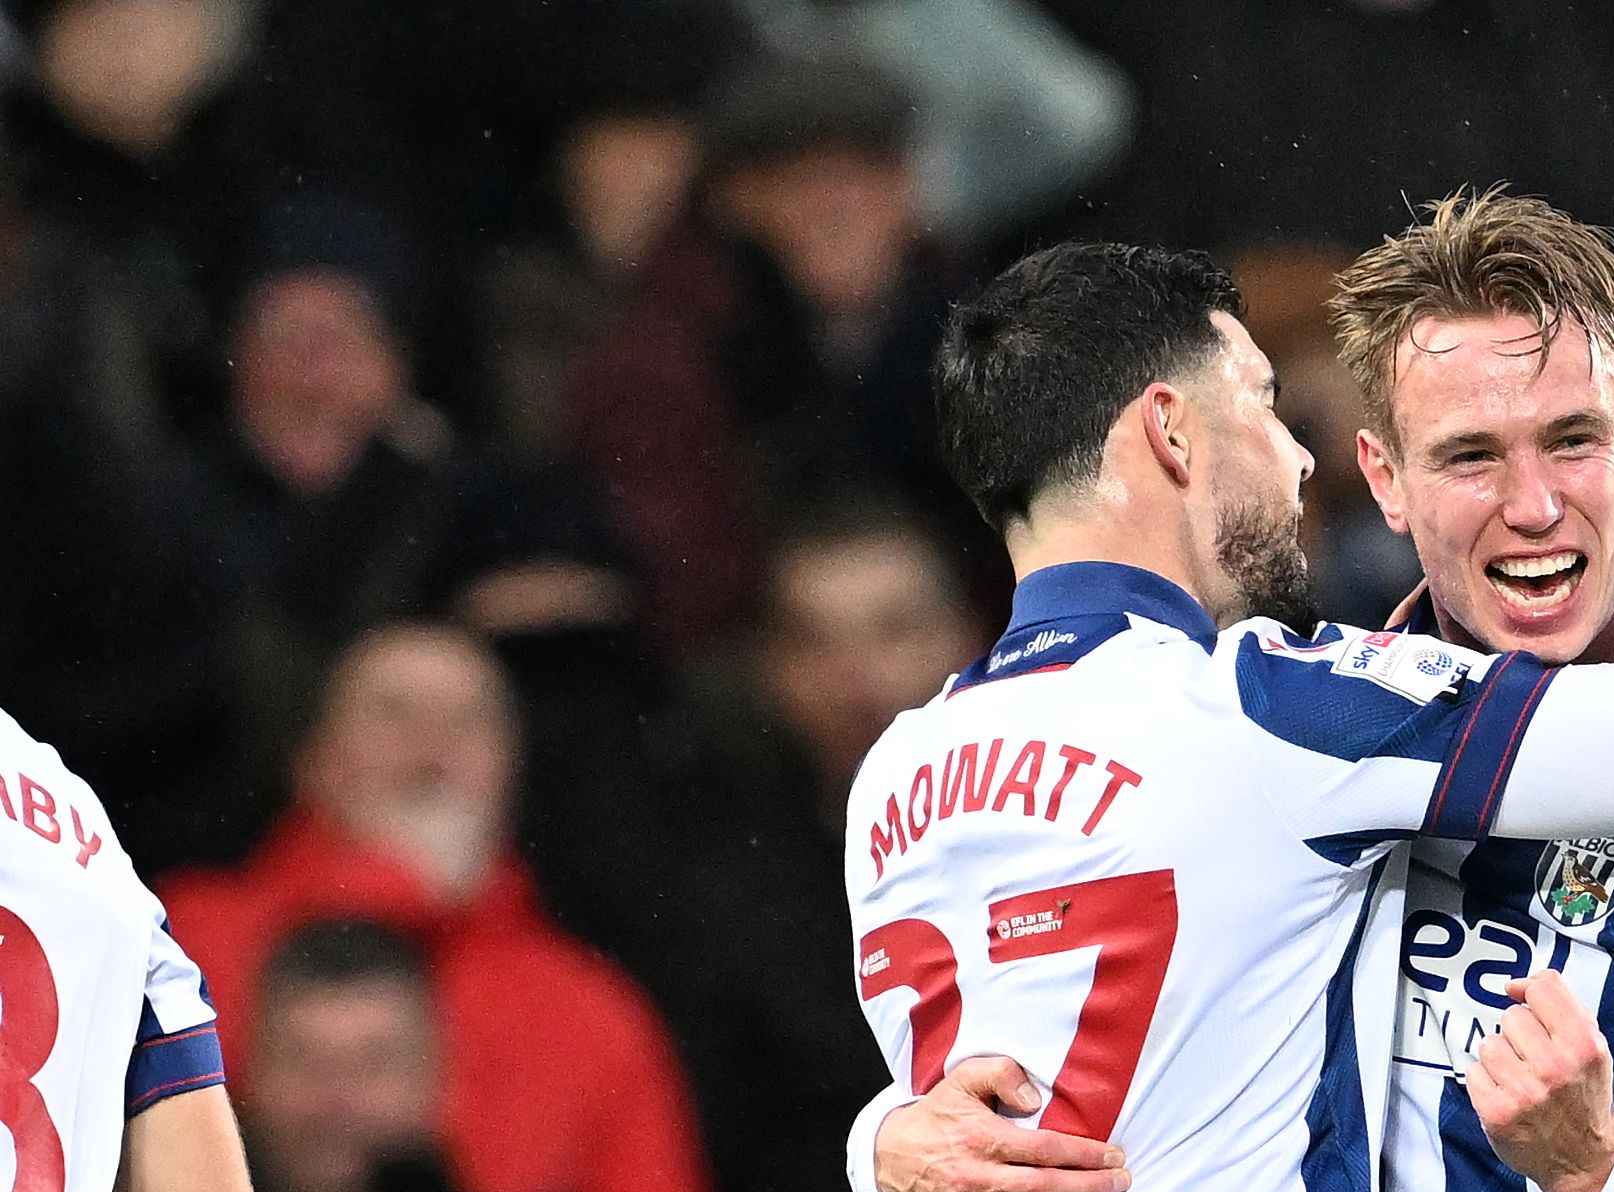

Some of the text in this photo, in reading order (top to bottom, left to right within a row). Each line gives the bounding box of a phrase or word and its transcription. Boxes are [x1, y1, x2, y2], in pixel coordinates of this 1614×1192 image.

[1353, 645, 1380, 670] sky
[870, 737, 1142, 884] MOWATT
[1012, 919, 1063, 938] COMMUNITY
[1026, 914, 1037, 925] IN
[1037, 911, 1054, 923] THE
[860, 868, 1178, 1144] 27
